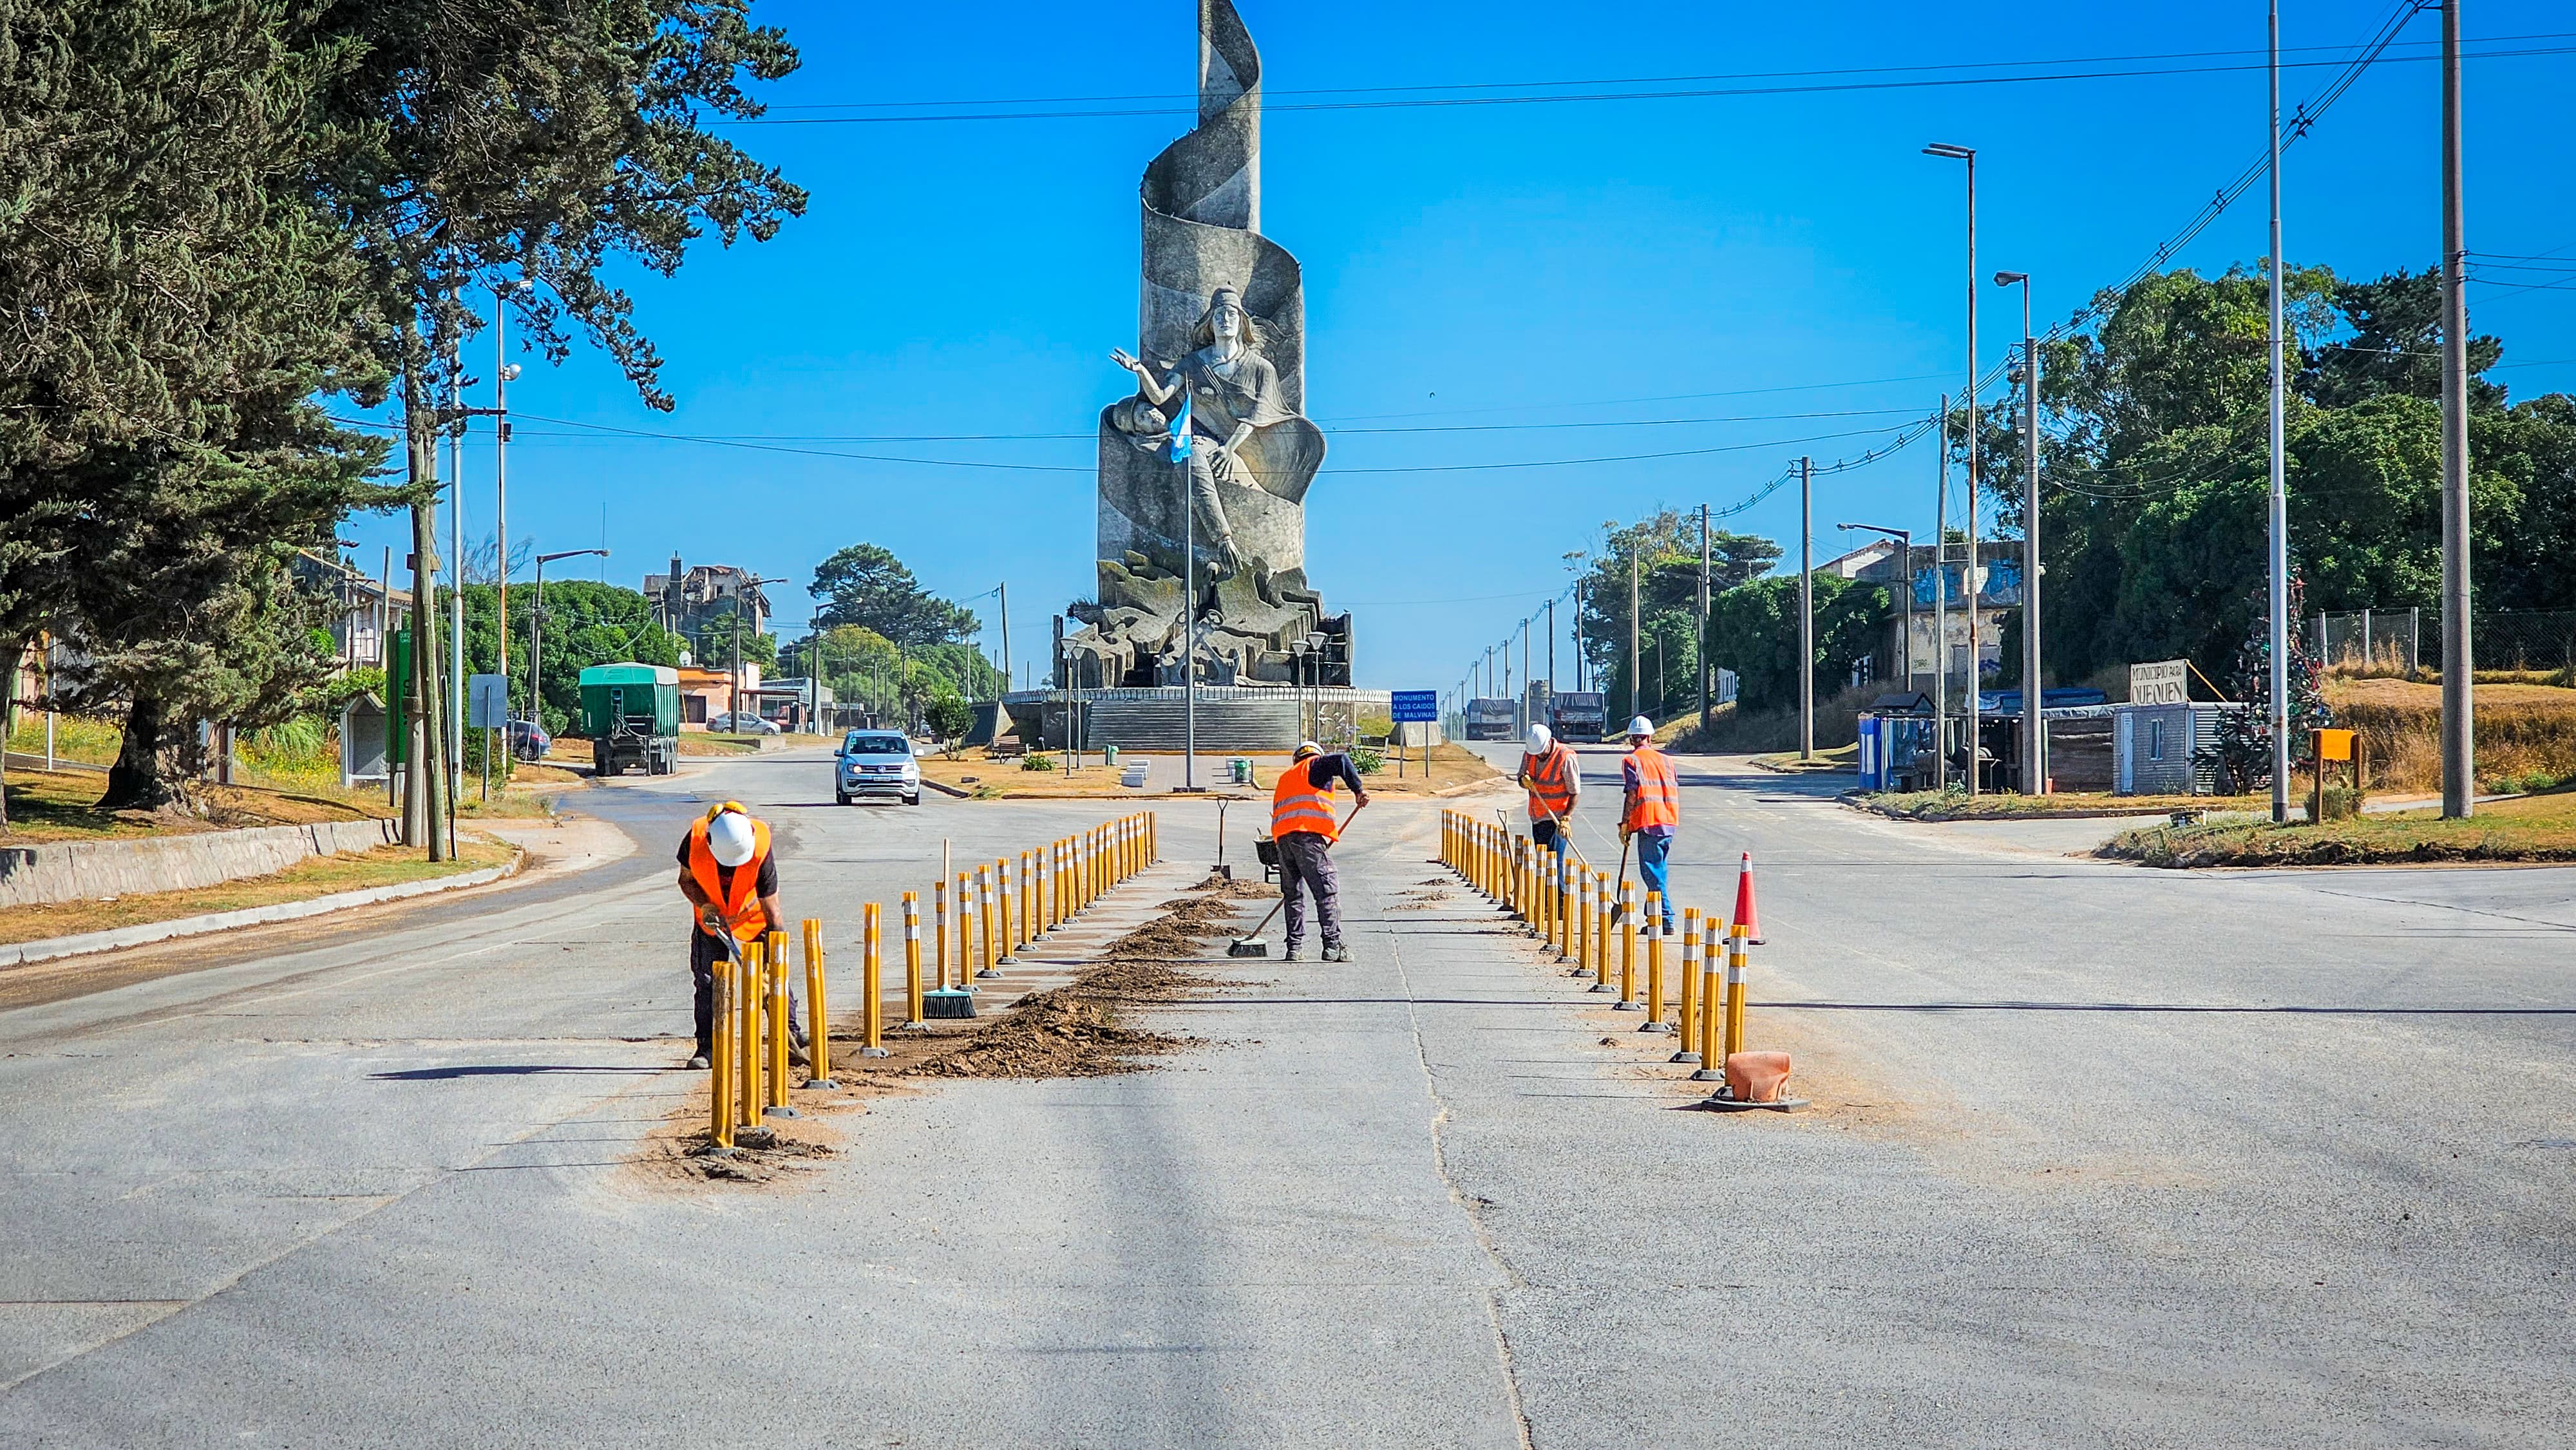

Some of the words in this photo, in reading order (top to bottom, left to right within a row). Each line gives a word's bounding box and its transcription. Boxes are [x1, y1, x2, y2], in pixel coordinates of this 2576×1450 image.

[2132, 665, 2168, 681] MUNICIPIO
[2169, 664, 2182, 677] PARA
[2132, 681, 2183, 705] QUEQUEN
